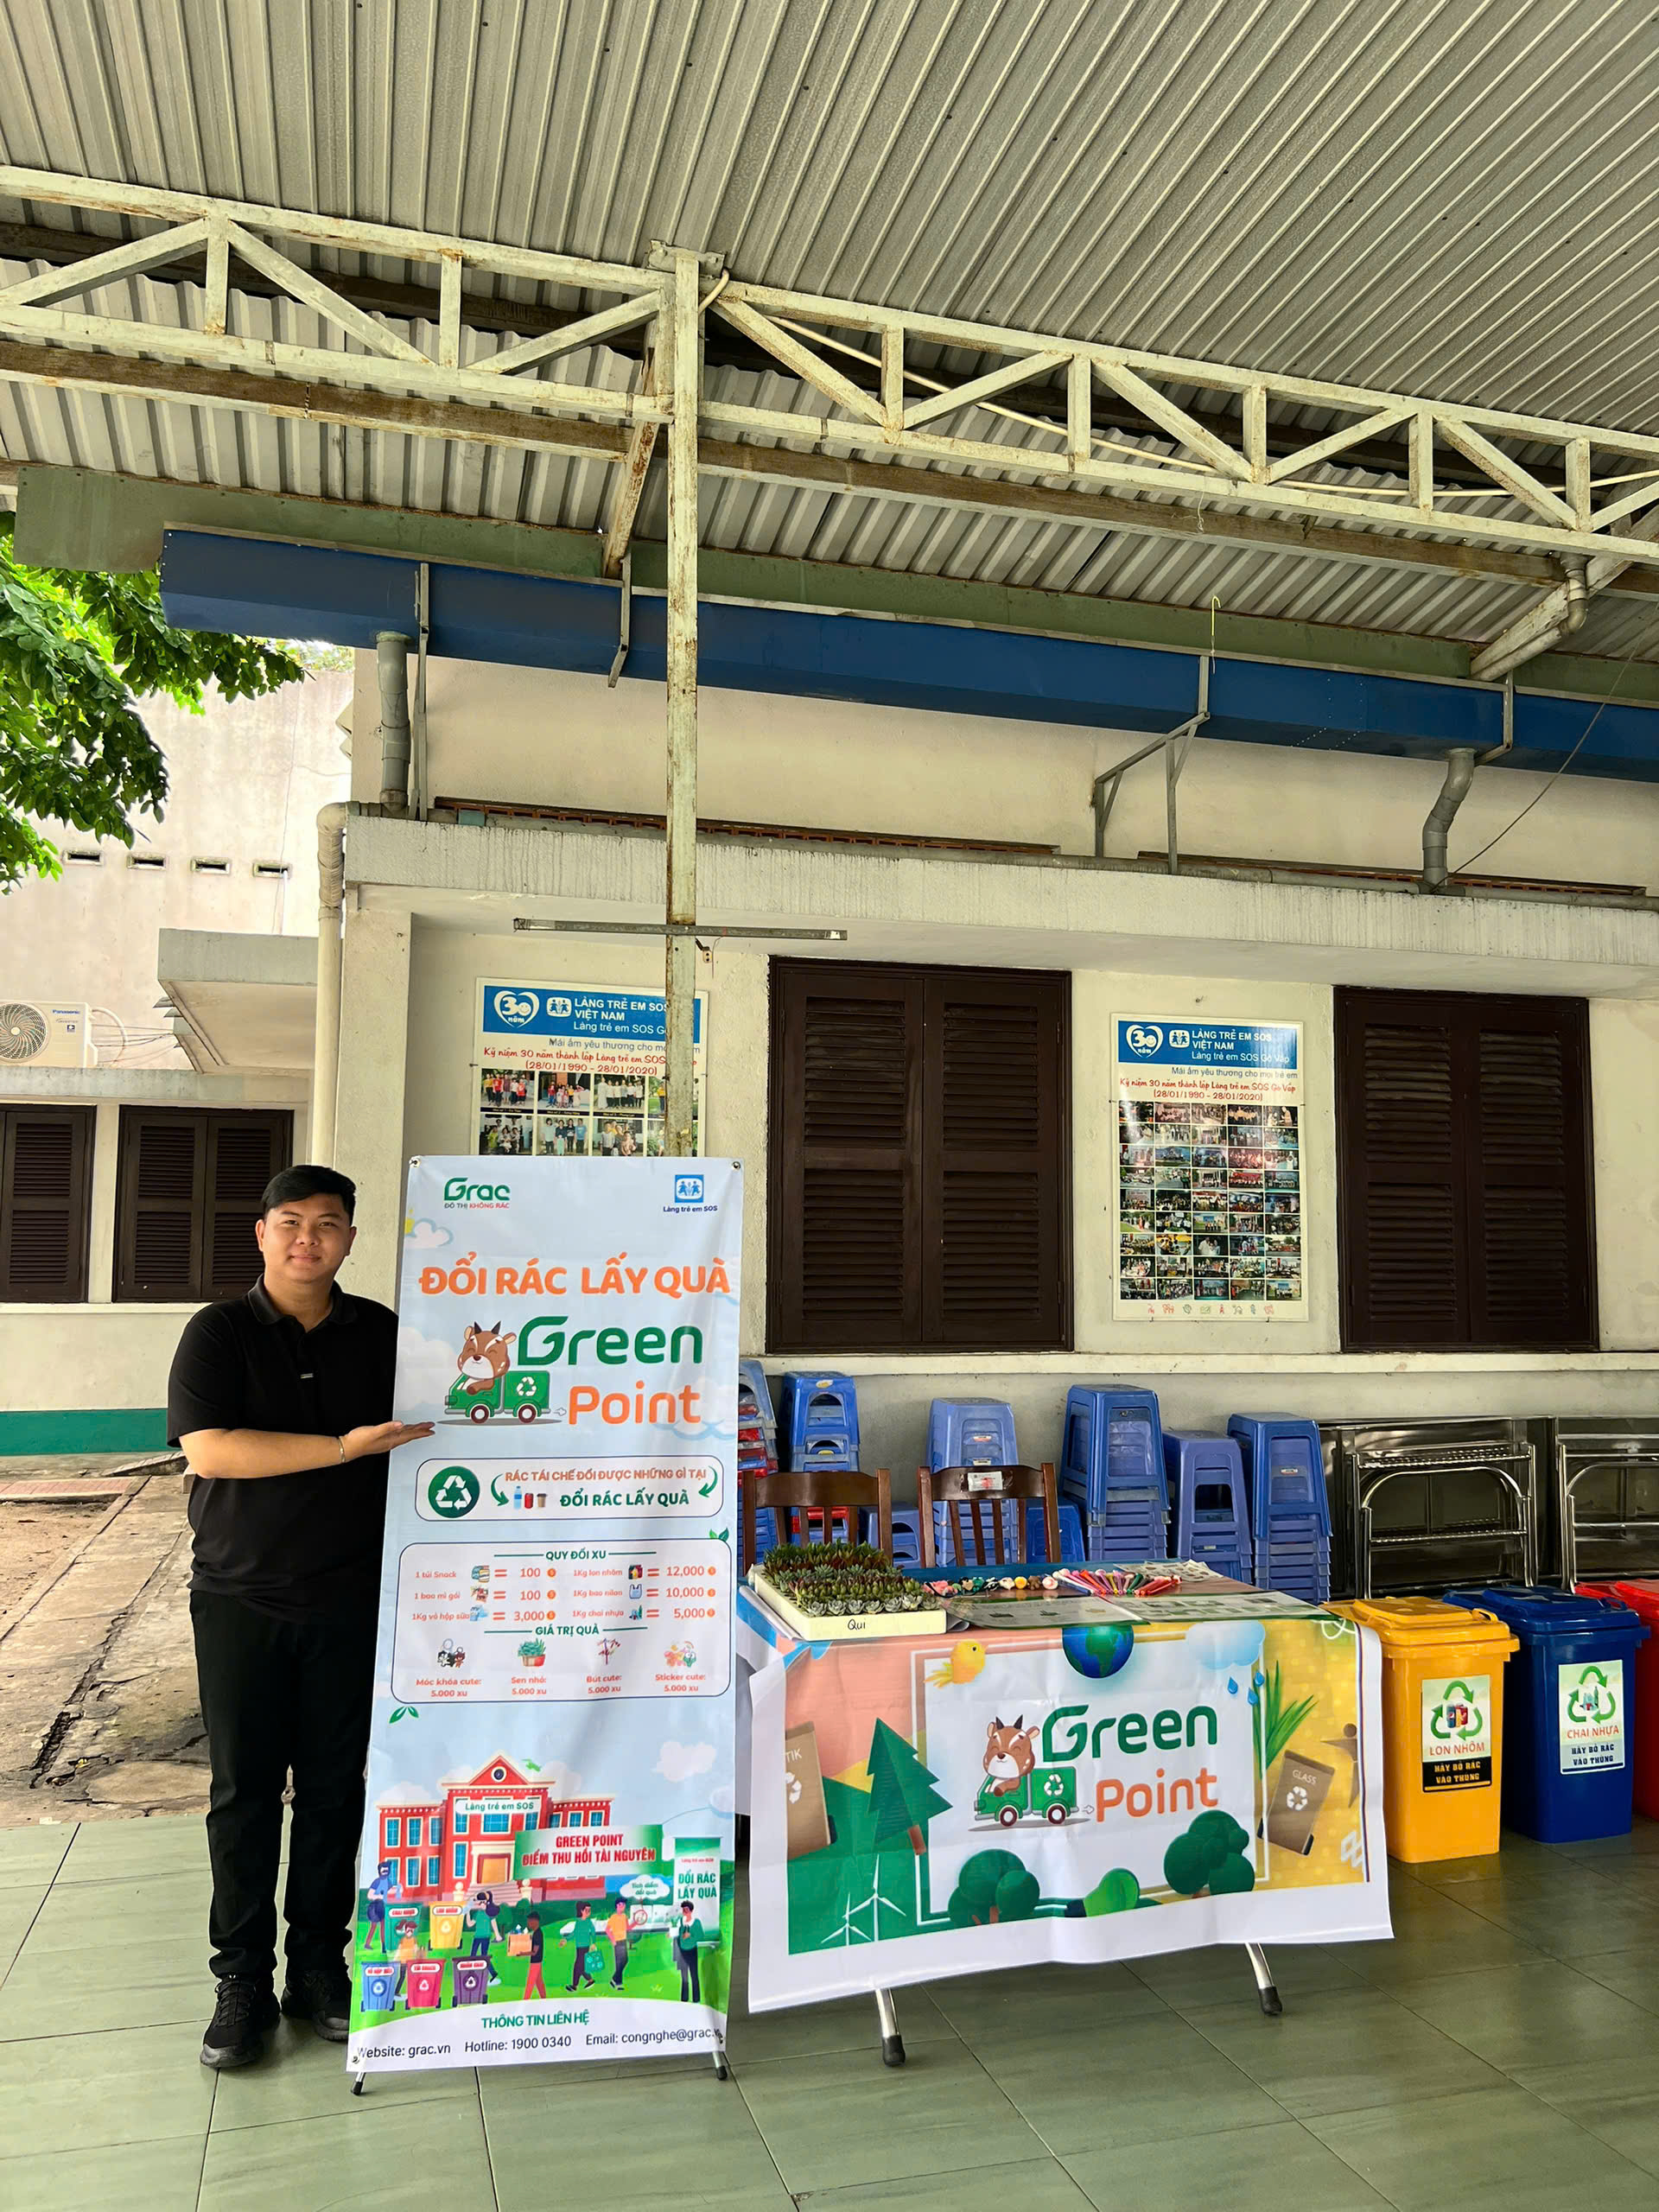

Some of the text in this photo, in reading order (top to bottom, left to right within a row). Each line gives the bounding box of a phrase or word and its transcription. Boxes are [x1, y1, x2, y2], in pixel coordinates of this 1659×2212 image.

[574, 996, 604, 1007] LÀNG
[607, 998, 627, 1009] TRẺ
[575, 1008, 625, 1021] VIỆT NAM
[574, 1021, 597, 1033] Làng
[600, 1023, 612, 1032] trẻ
[632, 1025, 653, 1033] SOS
[1192, 1028, 1217, 1039] LÀNG
[1219, 1029, 1236, 1039] TRẺ
[1254, 1033, 1272, 1042] SOS
[550, 1038, 565, 1047] Mái
[584, 1039, 600, 1049] yêu
[603, 1041, 634, 1052] thương
[638, 1042, 652, 1051] cho
[1192, 1039, 1211, 1051] VIỆT
[1192, 1052, 1211, 1061] Làng
[1172, 1066, 1185, 1075] Mái
[1201, 1068, 1214, 1077] yêu
[444, 1177, 510, 1201] Grac
[418, 1251, 730, 1299] ĐỔI RÁC LẤY QUÀ
[518, 1316, 702, 1366] Green
[569, 1381, 702, 1425] Point
[505, 1470, 529, 1481] RÁC
[531, 1470, 549, 1480] TÁI
[552, 1468, 575, 1480] CHẾ
[598, 1470, 630, 1482] ĐƯỢC
[634, 1469, 673, 1479] NHỮNG
[676, 1468, 686, 1478] GÌ
[688, 1470, 706, 1481] TẠI
[560, 1487, 690, 1507] ĐỔI RÁC LẤY QUÀ
[546, 1548, 607, 1560] QUY ĐỔI XU
[520, 1568, 541, 1578] 100
[574, 1569, 587, 1578] 1Kg
[666, 1567, 704, 1578] 12,000
[520, 1591, 541, 1600] 100
[666, 1587, 704, 1598] 10,000
[513, 1611, 544, 1622] 3,000
[674, 1608, 705, 1619] 5,000
[536, 1624, 600, 1637] GIÁ TRỊ QUÀ
[847, 1618, 866, 1630] Qui
[1042, 1704, 1217, 1762] Green
[1567, 1726, 1619, 1738] CHAI NHỰA
[1430, 1741, 1484, 1756] LON NHÔM
[1589, 1744, 1598, 1752] BỎ
[1452, 1761, 1463, 1770] BỎ
[1293, 1770, 1317, 1785] GLASS
[1436, 1775, 1452, 1783] VÀO
[1096, 1767, 1218, 1823] Point
[466, 1802, 485, 1811] Làng
[556, 1834, 624, 1848] GREEN POINT
[552, 1852, 570, 1865] THU
[595, 1848, 612, 1862] TÀI
[614, 1847, 656, 1862] NGUYÊN
[678, 1869, 715, 1884] ĐỔI RÁC
[678, 1884, 716, 1899] LẤY QUÀ
[481, 2009, 589, 2029] THÔNG TIN LIÊN HỆ
[409, 2044, 451, 2059] grac.vn
[465, 2039, 507, 2053] Hotline:
[512, 2037, 538, 2050] 1900
[542, 2036, 572, 2048] 0340
[586, 2033, 618, 2045] Email:
